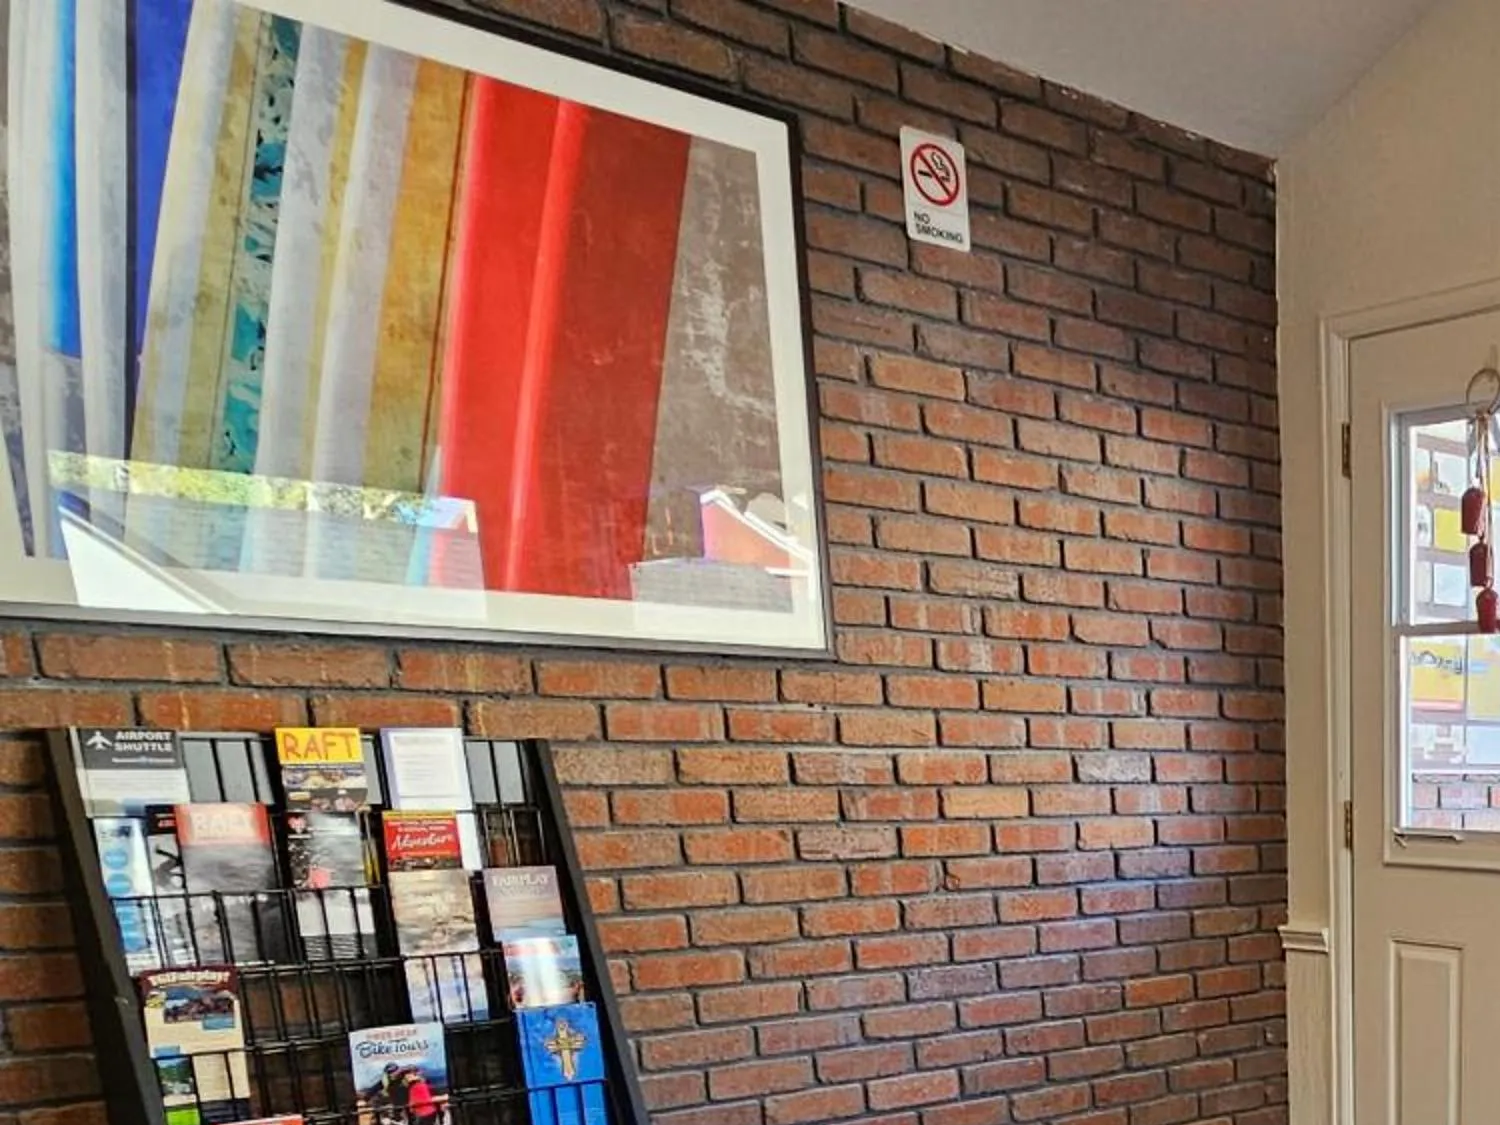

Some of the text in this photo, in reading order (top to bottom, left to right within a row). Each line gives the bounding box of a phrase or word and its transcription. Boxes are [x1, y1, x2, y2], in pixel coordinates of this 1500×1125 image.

[913, 211, 931, 224] NO
[915, 223, 964, 245] SMOKING
[114, 730, 172, 741] AIRPORT
[113, 742, 173, 752] SHUTTLE
[282, 731, 357, 761] RAFT
[355, 1041, 391, 1059] Bike
